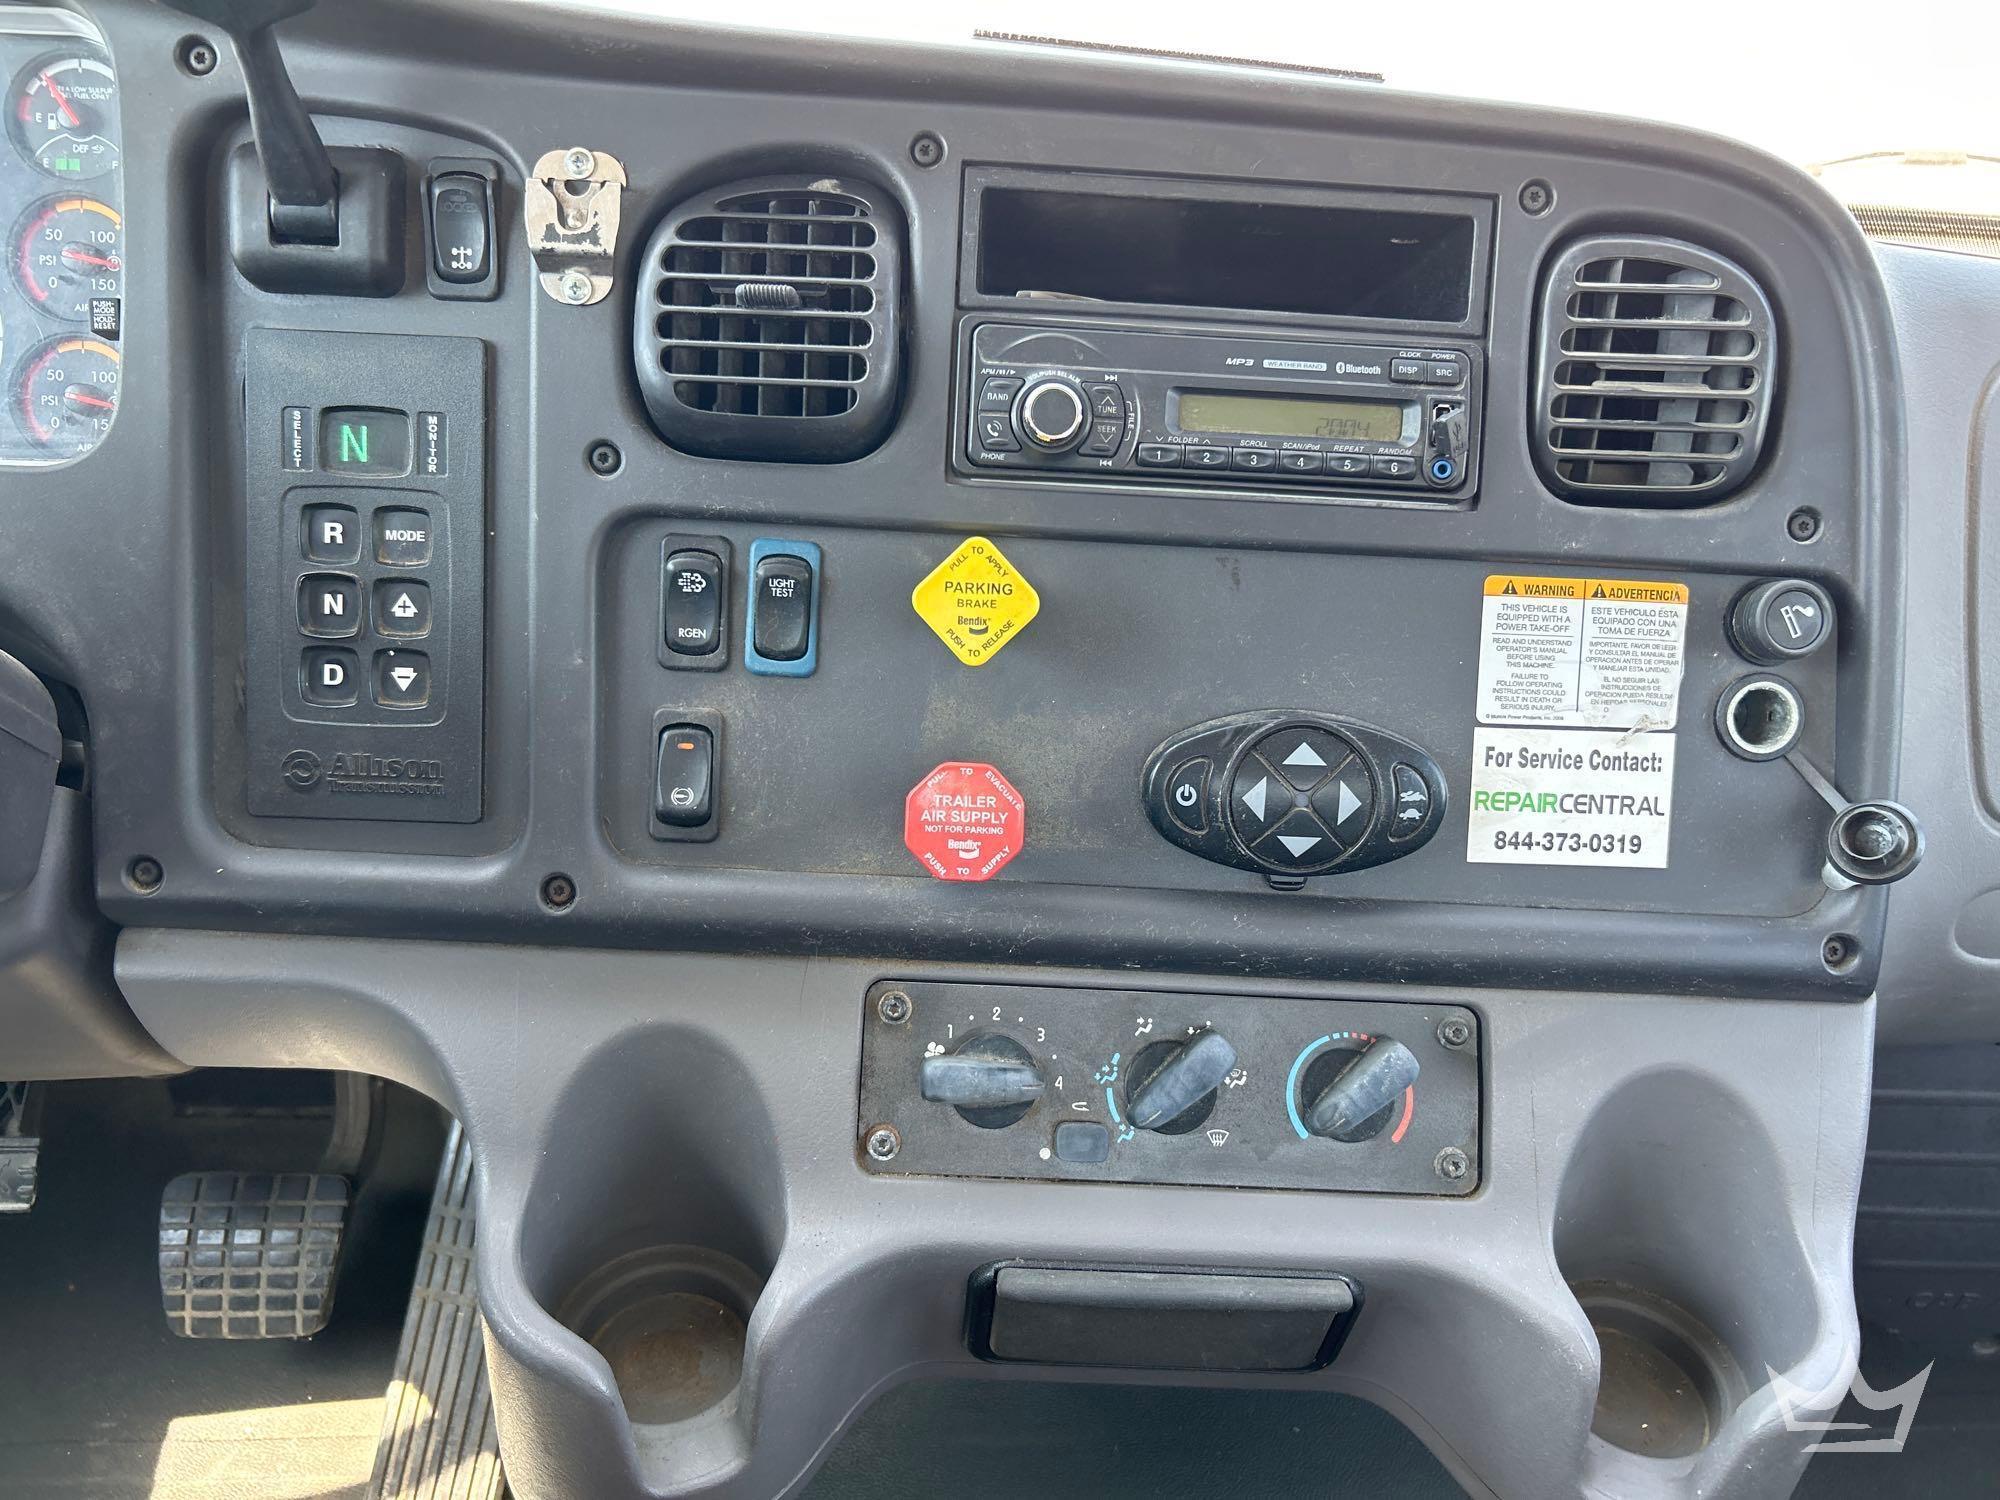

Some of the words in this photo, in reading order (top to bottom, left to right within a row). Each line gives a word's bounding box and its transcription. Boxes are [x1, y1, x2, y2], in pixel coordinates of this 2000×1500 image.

[35, 112, 42, 123] E
[73, 144, 89, 153] DEF
[43, 158, 49, 168] E
[112, 161, 119, 169] F
[45, 229, 63, 241] 50
[89, 230, 115, 244] 100
[39, 255, 56, 266] PSI
[49, 278, 58, 289] 0
[90, 278, 116, 291] 150
[1225, 358, 1254, 366] MP3
[1267, 361, 1301, 369] WEATHER
[1346, 363, 1381, 375] Bluetooth
[1399, 366, 1418, 374] DISP
[46, 369, 64, 381] 50
[91, 370, 116, 383] 100
[41, 395, 58, 406] PSI
[987, 392, 1009, 401] BAND
[1098, 406, 1117, 414] TUNE
[51, 417, 60, 428] 0
[92, 418, 109, 430] 15
[293, 411, 301, 467] SELECT
[340, 425, 368, 463] N
[428, 416, 438, 473] MONITOR
[1168, 436, 1199, 444] FOLDER
[1282, 442, 1320, 450] SCAN/iPod
[1333, 445, 1365, 453] REPEAT
[980, 453, 1006, 461] PHONE
[1157, 451, 1161, 460] 1
[1203, 453, 1210, 463] 2
[1250, 455, 1257, 465] 3
[1297, 457, 1304, 467] 4
[1344, 460, 1351, 469] 5
[1390, 462, 1398, 472] 6
[323, 522, 344, 544] R
[385, 530, 426, 542] MODE
[949, 553, 969, 571] PULL
[971, 546, 984, 555] TO
[986, 555, 1009, 578] APPLY
[768, 578, 796, 590] LIGHT
[945, 581, 1013, 596] PARKING
[771, 587, 794, 598] TEST
[1524, 584, 1574, 596] WARNING
[1609, 588, 1680, 600] ADVERTENCIA
[323, 593, 344, 615] N
[957, 599, 997, 609] BRAKE
[1501, 603, 1520, 611] THIS
[1522, 605, 1557, 613] VEHICLE
[1591, 607, 1612, 615] ESTE
[957, 616, 989, 626] Bendix
[1496, 613, 1539, 621] EQUIPPED
[1593, 617, 1635, 626] EQUIPADO
[678, 627, 707, 639] RGEN
[1496, 623, 1527, 631] POWER
[1530, 624, 1570, 632] TAKE-OFF
[1637, 628, 1670, 636] FUERZA
[946, 628, 966, 649] PUSH
[968, 649, 981, 657] TO
[981, 619, 1015, 651] RELEASE
[323, 663, 344, 686] D
[1484, 746, 1513, 767] For
[1518, 747, 1583, 770] Service
[1589, 749, 1663, 772] Contact:
[327, 752, 444, 778] Allison
[927, 770, 949, 788] PULL
[960, 767, 973, 775] TO
[985, 770, 1022, 811] EVACUATE
[934, 795, 997, 808] TRAILER
[1474, 790, 1665, 816] REPAIRCENTRAL
[920, 810, 946, 822] AIR
[951, 810, 1008, 824] SUPPLY
[945, 825, 963, 833] FOR
[965, 826, 1004, 835] PARKING
[948, 839, 980, 850] Bendix
[1494, 831, 1642, 854] 844-373-0319
[924, 852, 947, 876] PUSH
[981, 845, 1011, 874] SUPPLY
[992, 1006, 1001, 1021] 2
[947, 1024, 953, 1038] 1
[1037, 1028, 1046, 1042] 3
[1054, 1076, 1063, 1090] 4
